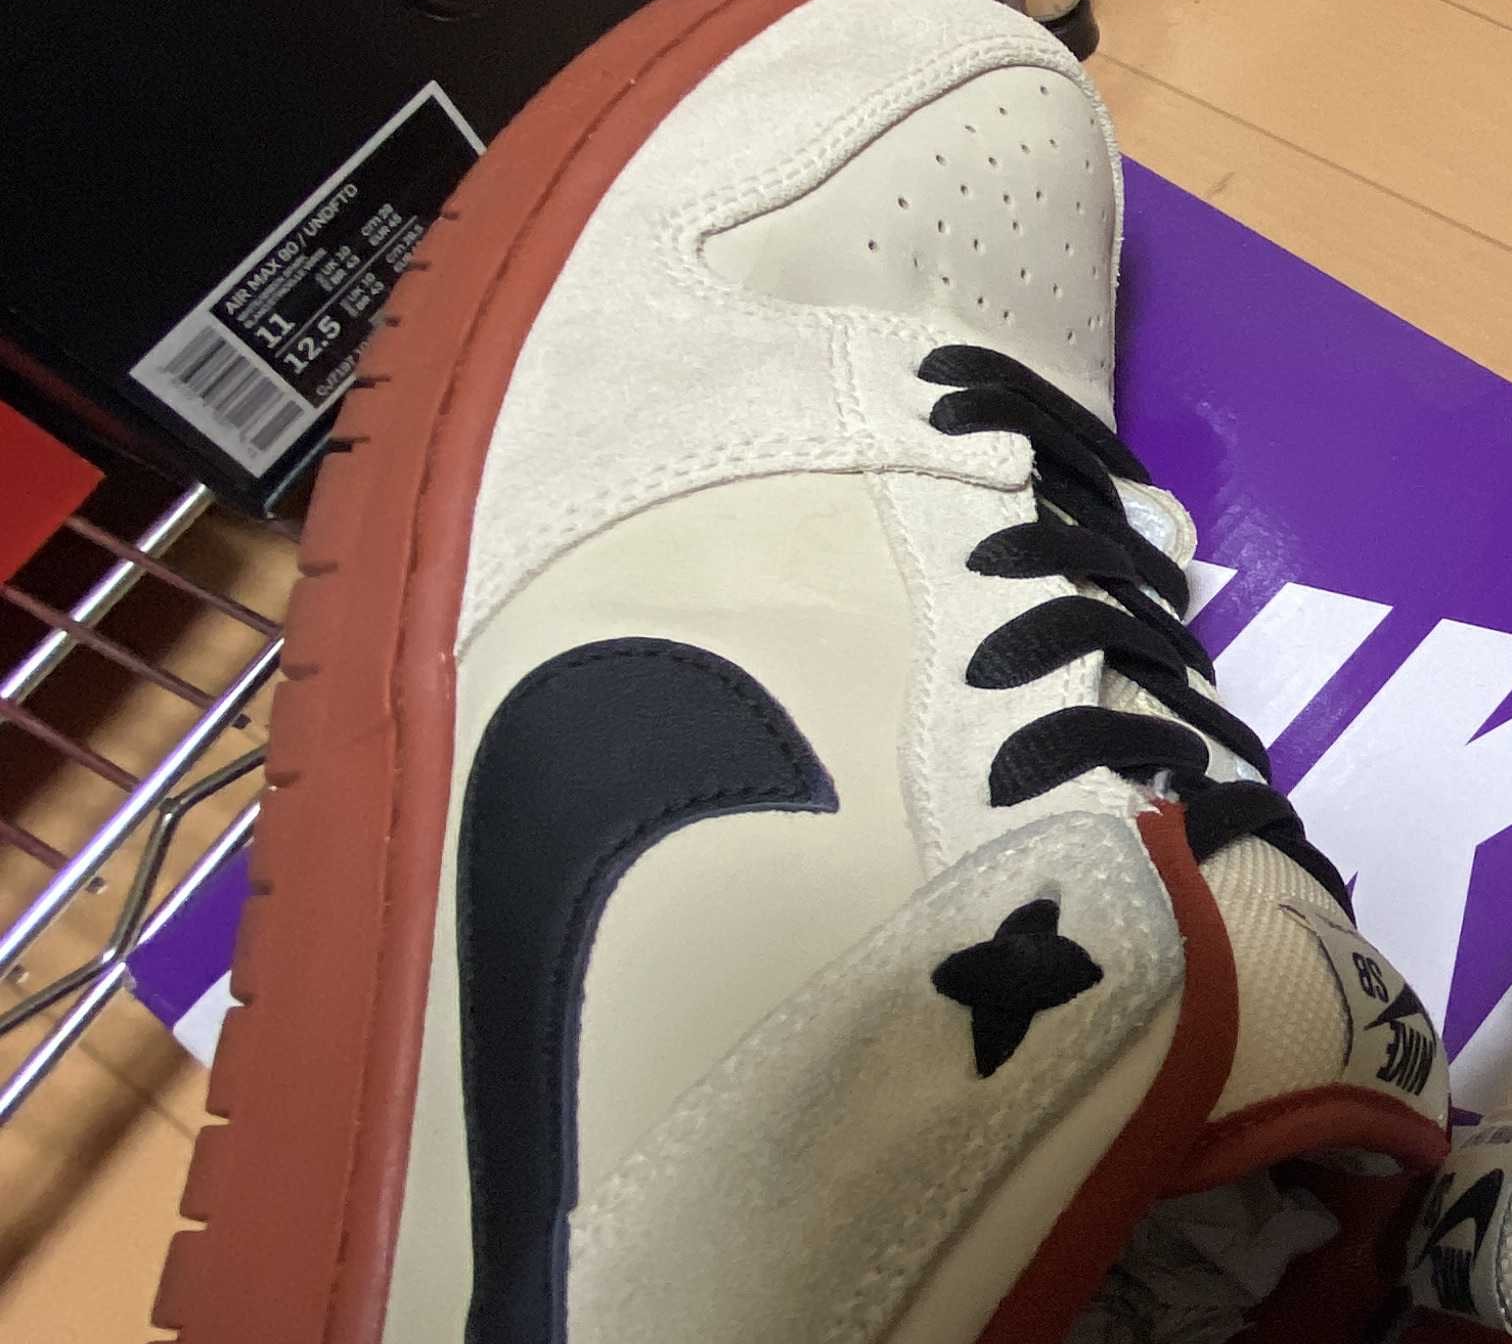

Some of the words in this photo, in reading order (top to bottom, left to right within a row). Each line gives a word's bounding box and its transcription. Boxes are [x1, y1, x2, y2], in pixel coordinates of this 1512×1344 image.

[225, 288, 252, 315] AIR
[246, 257, 282, 291] MAX
[302, 183, 358, 237] UNDFTD
[254, 313, 296, 349] 11
[283, 315, 341, 374] 12.5
